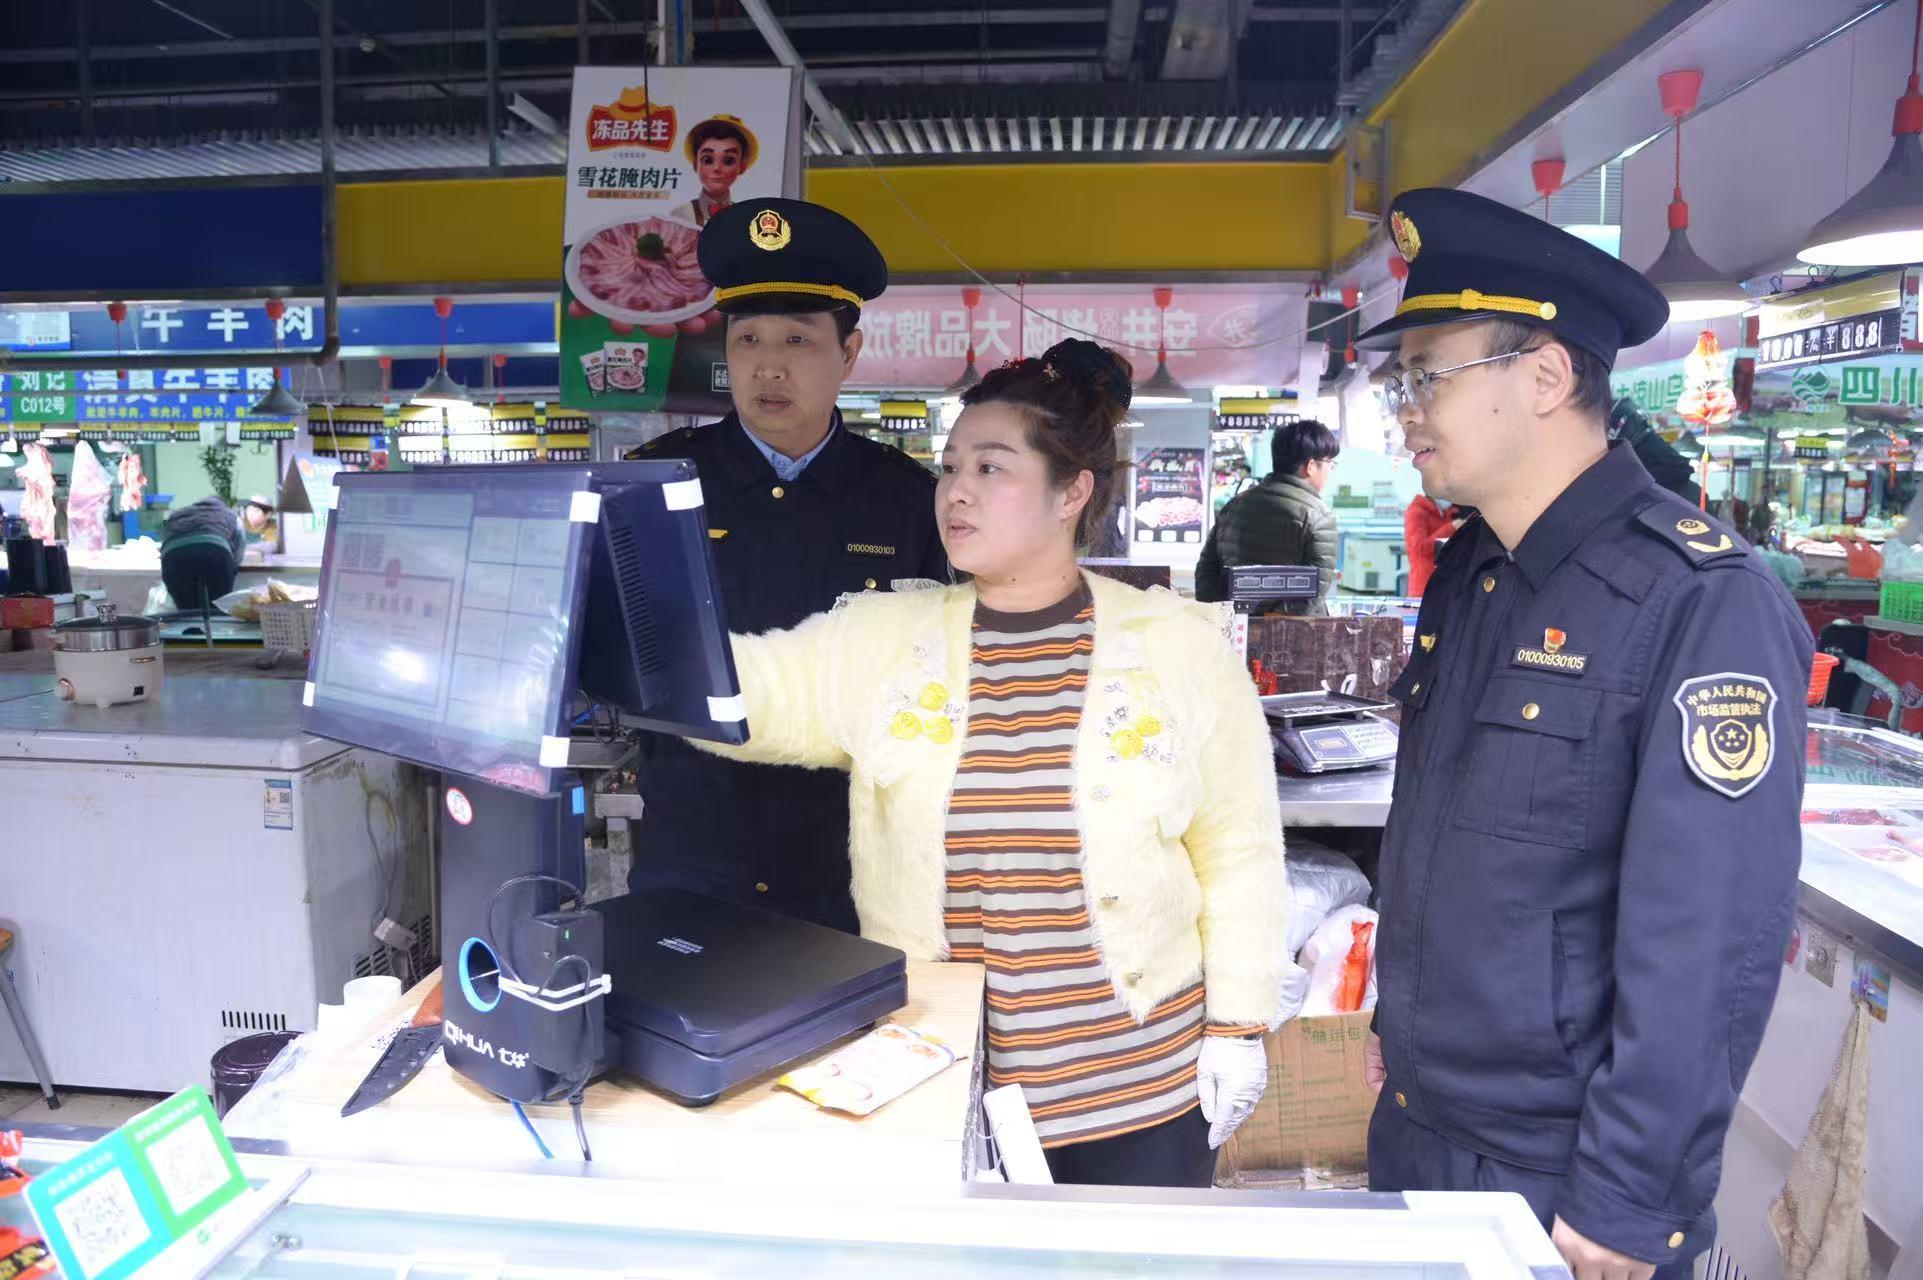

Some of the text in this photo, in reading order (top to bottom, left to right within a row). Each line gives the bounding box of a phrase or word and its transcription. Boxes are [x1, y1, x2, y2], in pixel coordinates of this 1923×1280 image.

[592, 119, 670, 141] 冻品先生
[577, 166, 682, 190] 雪花腌肉片
[21, 396, 65, 415] C012号
[1517, 649, 1586, 669] 01000930105
[1686, 685, 1768, 706] 中华人民共和国
[1696, 703, 1763, 717] 市场监督执法
